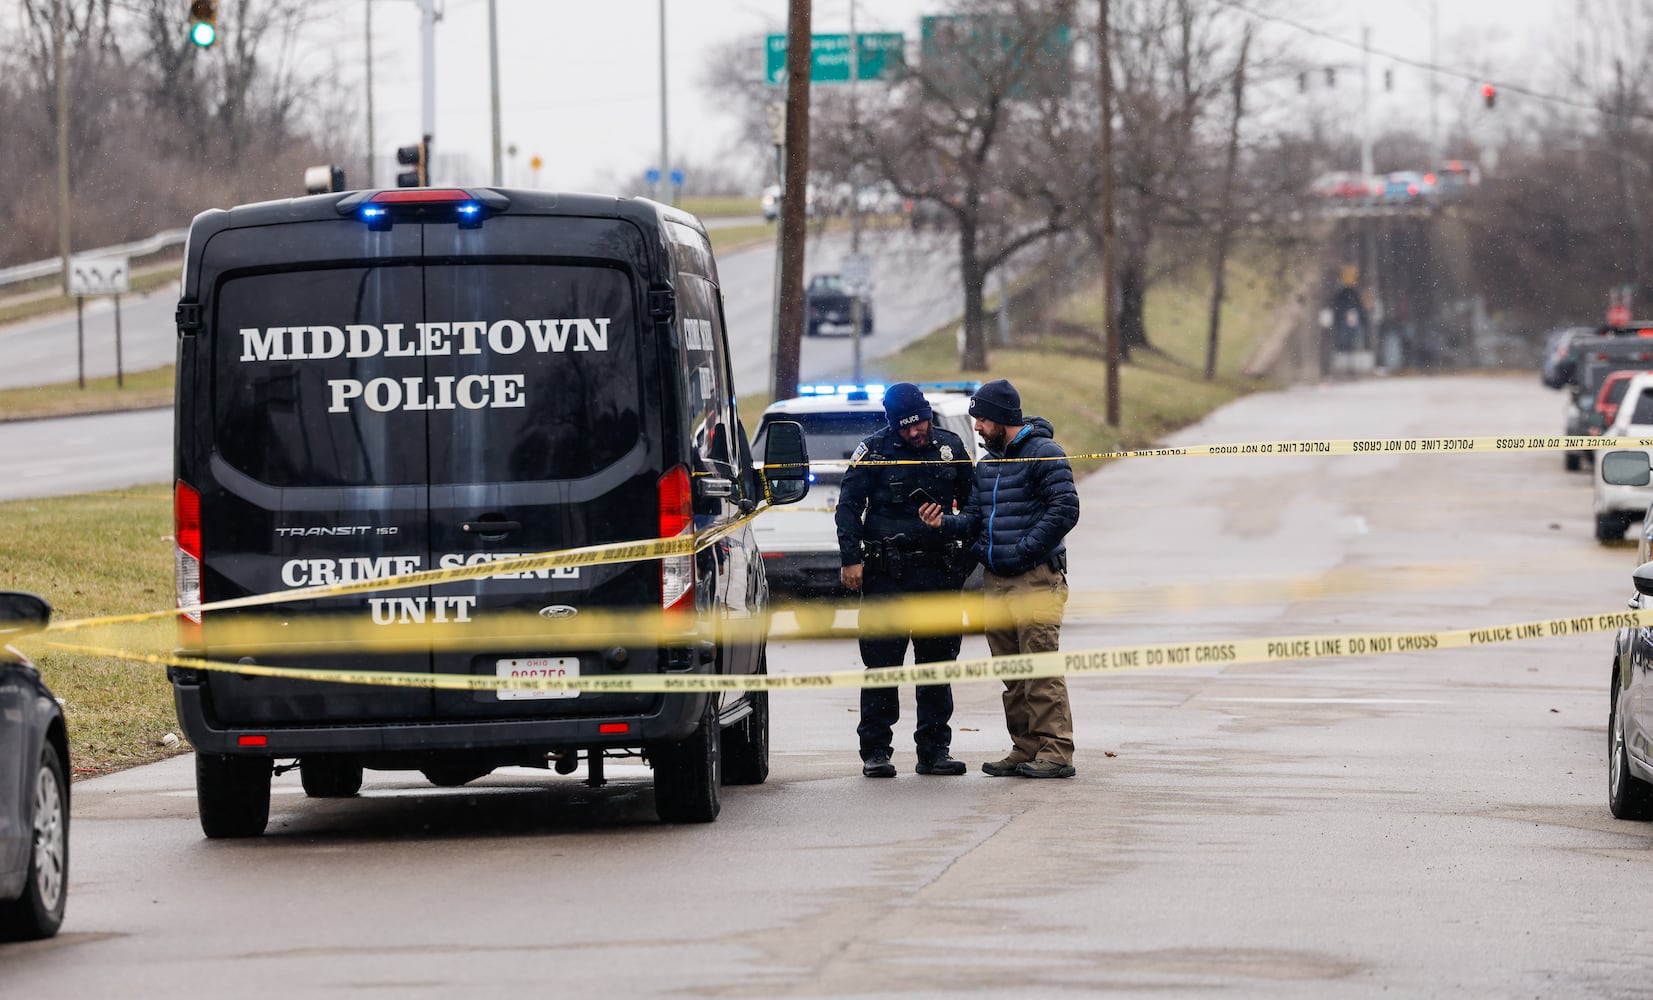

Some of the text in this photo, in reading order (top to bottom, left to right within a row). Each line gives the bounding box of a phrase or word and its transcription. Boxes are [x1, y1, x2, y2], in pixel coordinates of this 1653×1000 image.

[239, 318, 610, 362] MIDDLETOWN
[327, 374, 525, 413] POLICE
[900, 414, 920, 427] POLICE
[1241, 445, 1258, 454] NOT
[1260, 444, 1273, 453] DO
[1277, 443, 1297, 452] LINE
[1299, 441, 1330, 452] POLICE
[1353, 439, 1474, 452] POLICE LINE DO NOT CROSS
[1496, 438, 1617, 449] POLICE LINE DO NOT CROSS
[275, 526, 399, 537] TRANSIT 150
[281, 555, 421, 587] CRIME
[368, 595, 476, 625] UNIT
[1469, 613, 1640, 644] POLICE LINE DO NOT CROSS
[1267, 634, 1438, 658] POLICE LINE DO NOT CROSS
[1064, 644, 1236, 671] POLICE LINE DO NOT CROSS
[864, 658, 1034, 683] POLICE LINE DO NOT CROSS
[664, 675, 833, 688] POLICE LINE DO NOT CROSS
